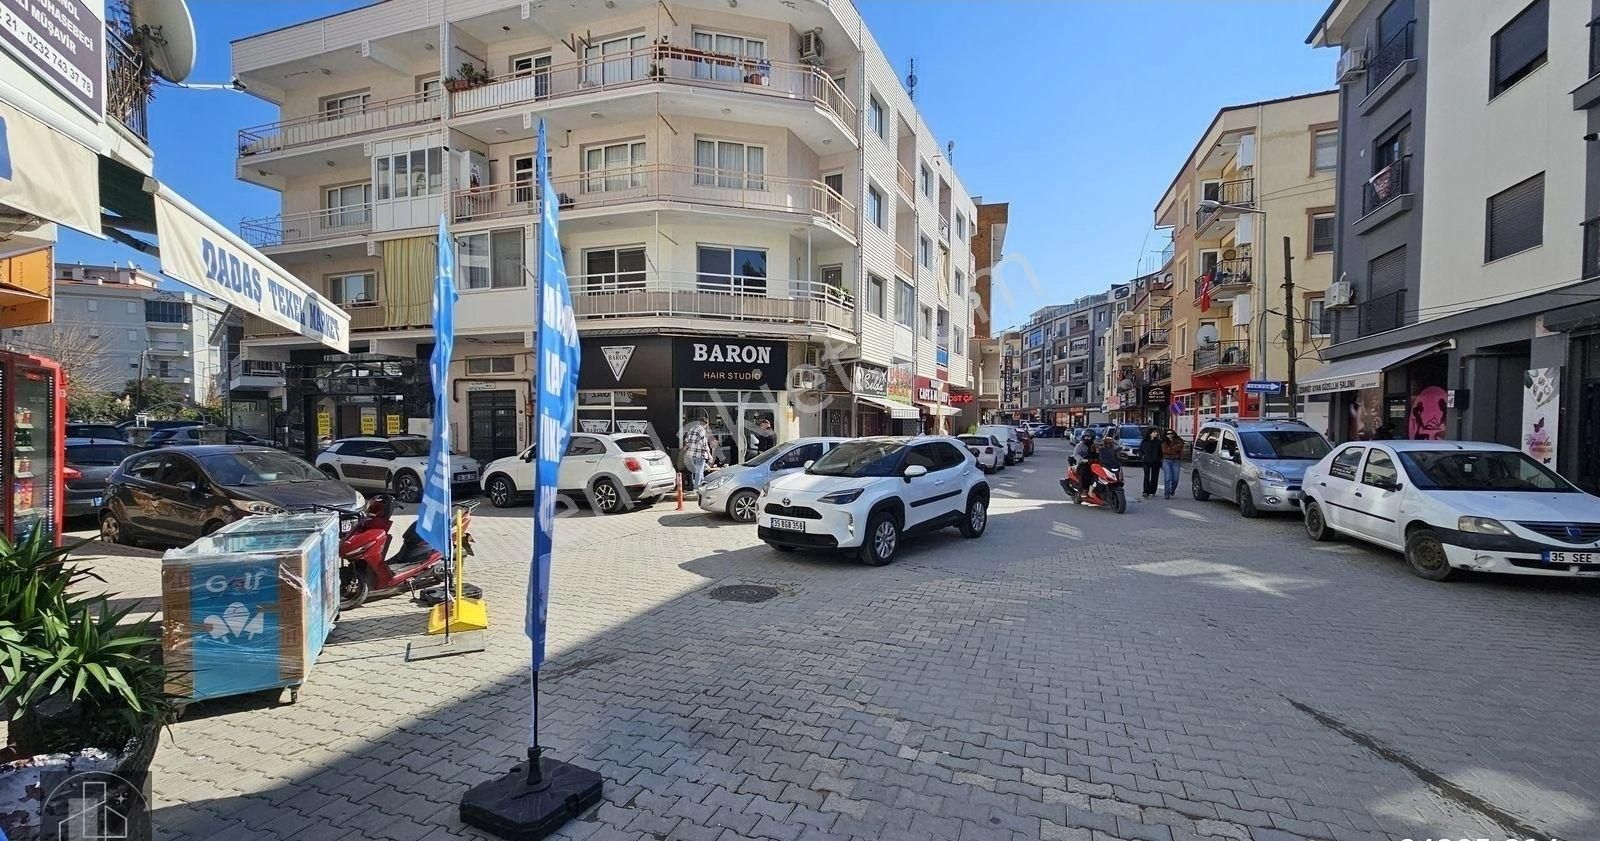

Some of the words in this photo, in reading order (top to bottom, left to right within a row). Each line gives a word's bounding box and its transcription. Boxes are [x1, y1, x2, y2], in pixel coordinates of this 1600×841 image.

[31, 4, 77, 55] MÜŞAVİR
[6, 13, 17, 31] 21
[27, 31, 50, 59] 0232
[52, 53, 68, 74] 743
[70, 68, 80, 83] 37
[81, 77, 92, 93] 78
[202, 237, 262, 312] DADAŞ
[267, 278, 306, 326] TEKEL
[608, 353, 628, 362] BARON
[692, 343, 771, 364] BARON
[703, 371, 725, 380] HAIR
[727, 372, 761, 381] STUDIO
[1551, 552, 1565, 562] 35
[1572, 553, 1592, 563] SEE
